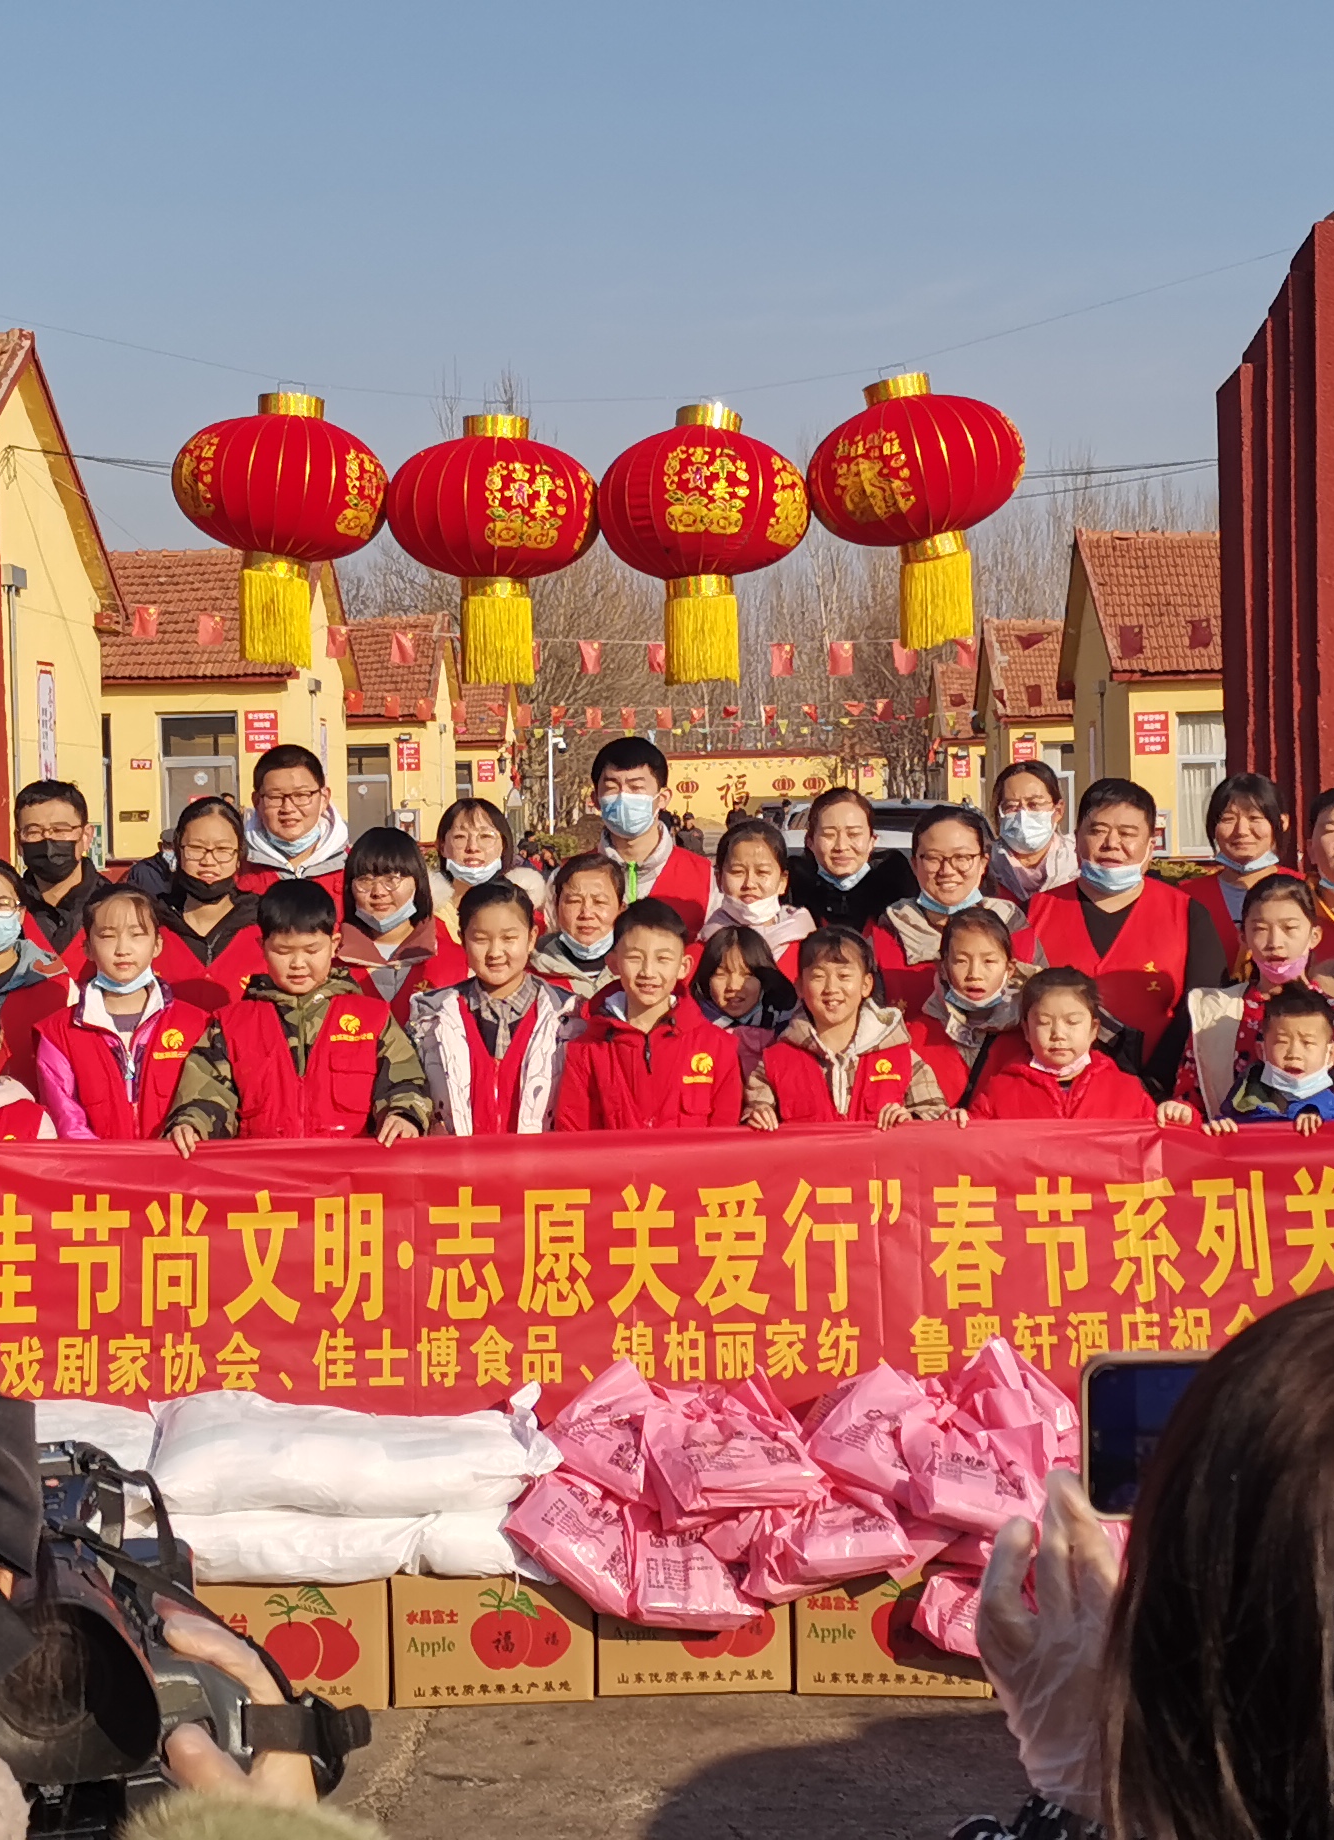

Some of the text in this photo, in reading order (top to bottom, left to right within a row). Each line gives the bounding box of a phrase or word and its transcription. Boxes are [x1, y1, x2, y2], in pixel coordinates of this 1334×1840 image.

[716, 773, 750, 808] 福
[807, 1596, 859, 1612] 水晶富士
[406, 1609, 458, 1625] 水晶富士
[806, 1622, 857, 1643] Apple
[406, 1637, 456, 1657] Apple
[492, 1631, 515, 1654] 福
[617, 1669, 775, 1685] 山东优质苹果生产基地
[413, 1680, 573, 1699] 山东优质苹果生产基地
